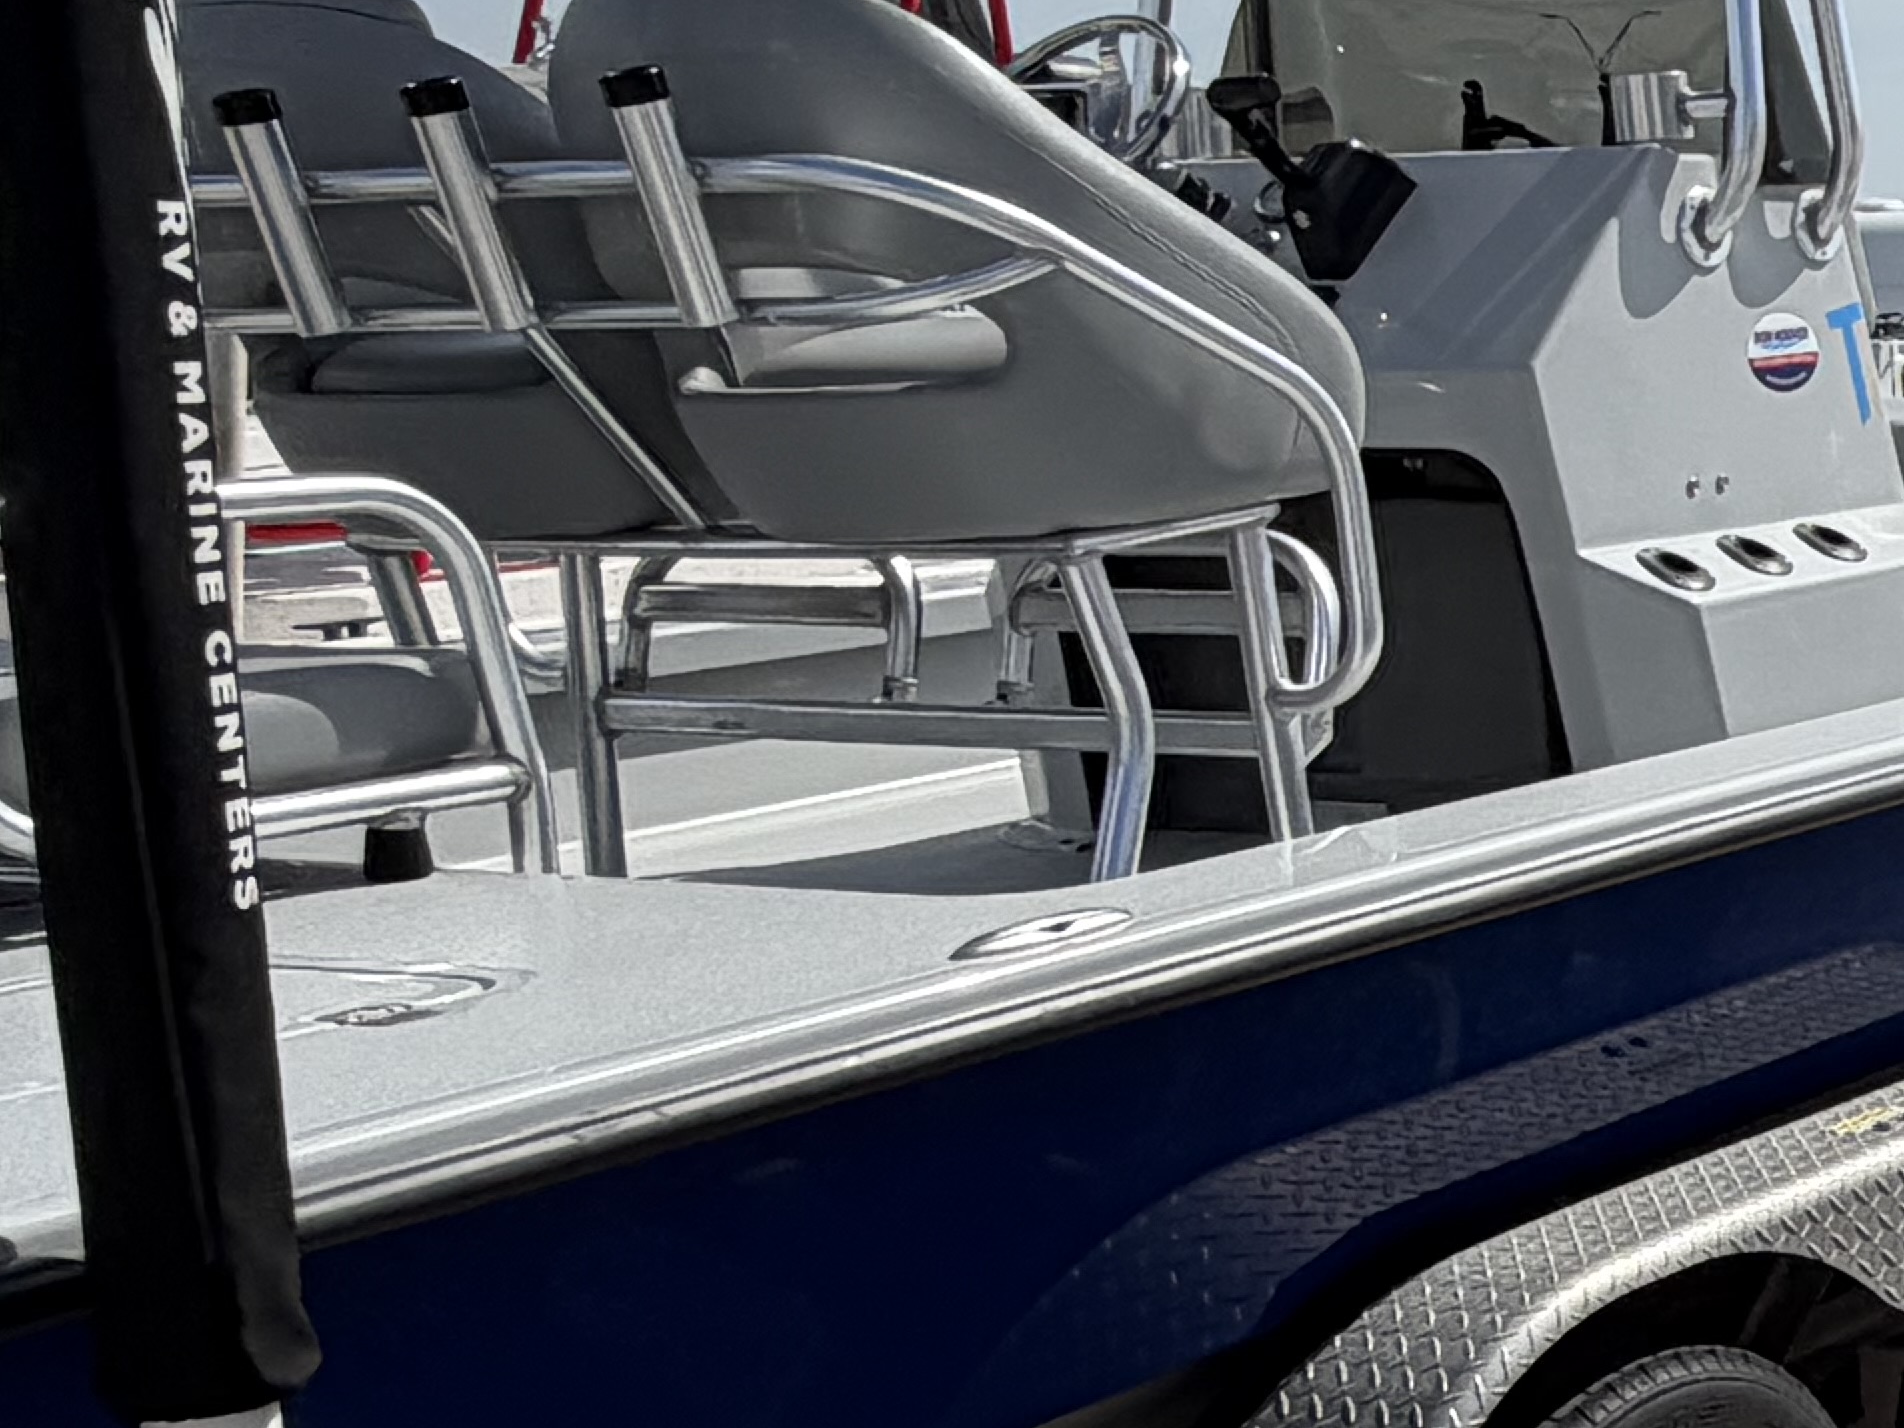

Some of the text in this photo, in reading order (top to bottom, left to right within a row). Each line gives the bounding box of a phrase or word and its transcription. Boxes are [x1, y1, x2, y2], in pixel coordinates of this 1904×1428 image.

[155, 199, 195, 283] RV
[166, 300, 199, 338] &
[172, 359, 226, 606] MARINE
[204, 628, 258, 912] CENTERS
